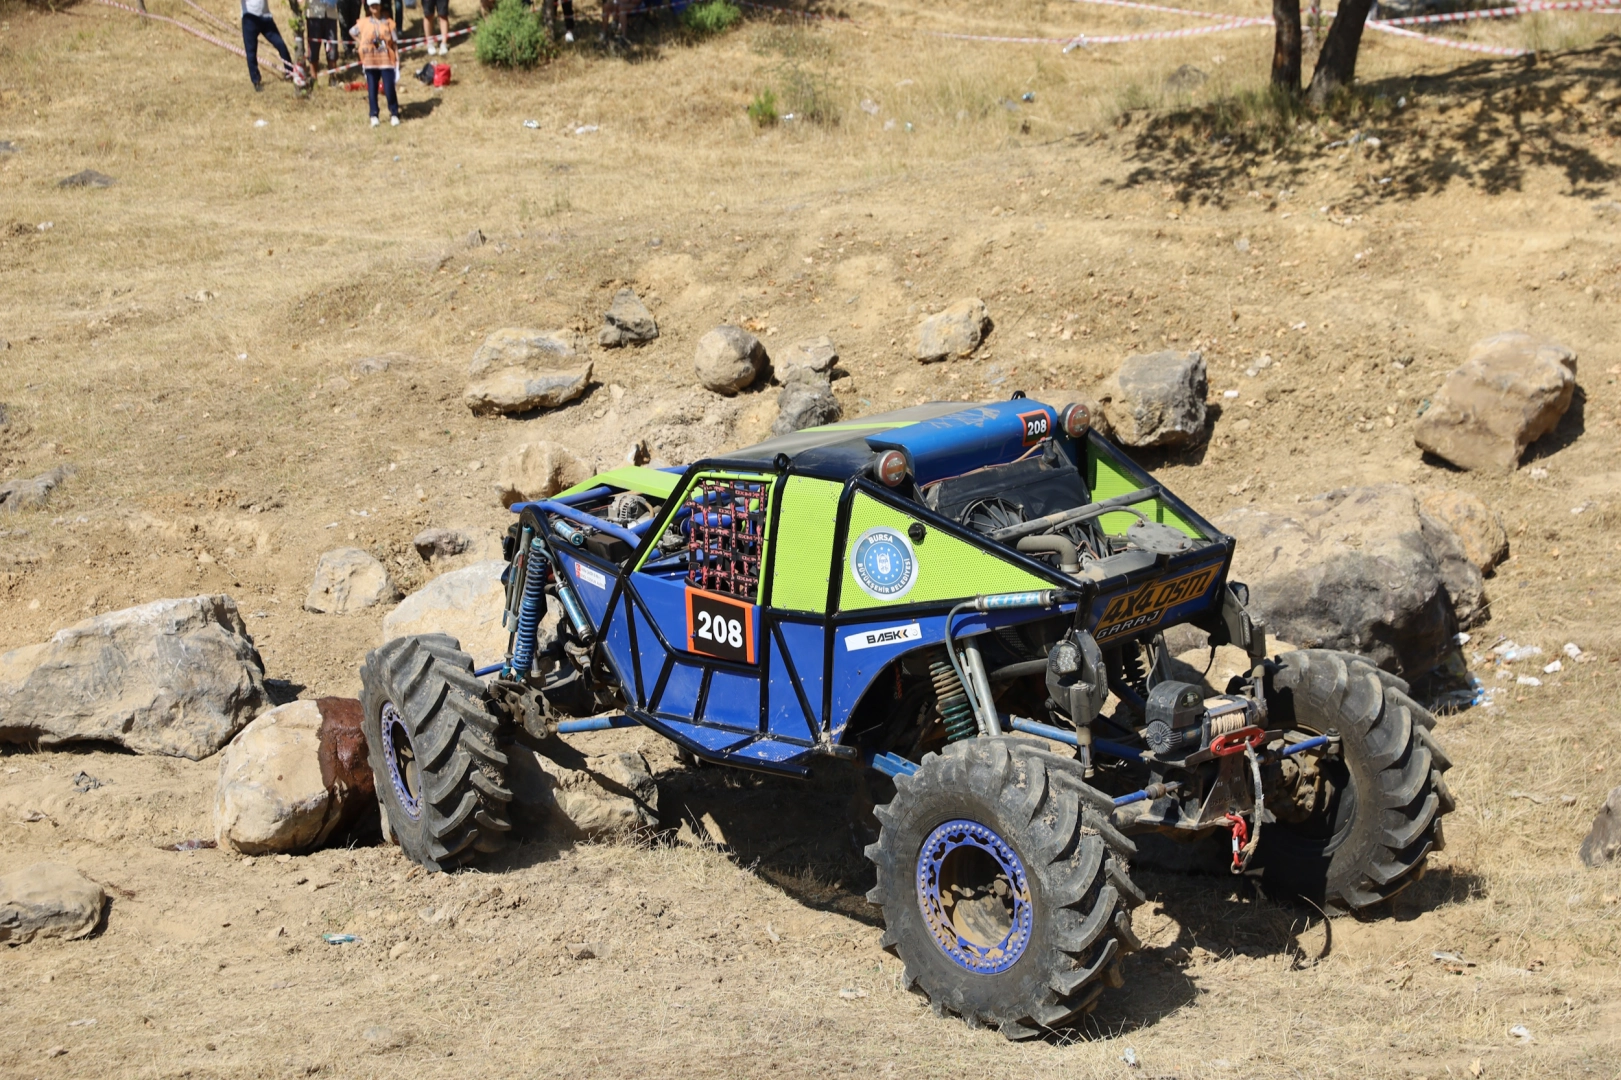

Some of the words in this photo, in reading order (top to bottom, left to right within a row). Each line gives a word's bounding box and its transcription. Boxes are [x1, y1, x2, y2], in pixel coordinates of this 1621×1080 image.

[1027, 418, 1048, 437] 208
[868, 533, 893, 545] BURSA
[697, 610, 744, 649] 208
[1096, 609, 1161, 640] GARAJ
